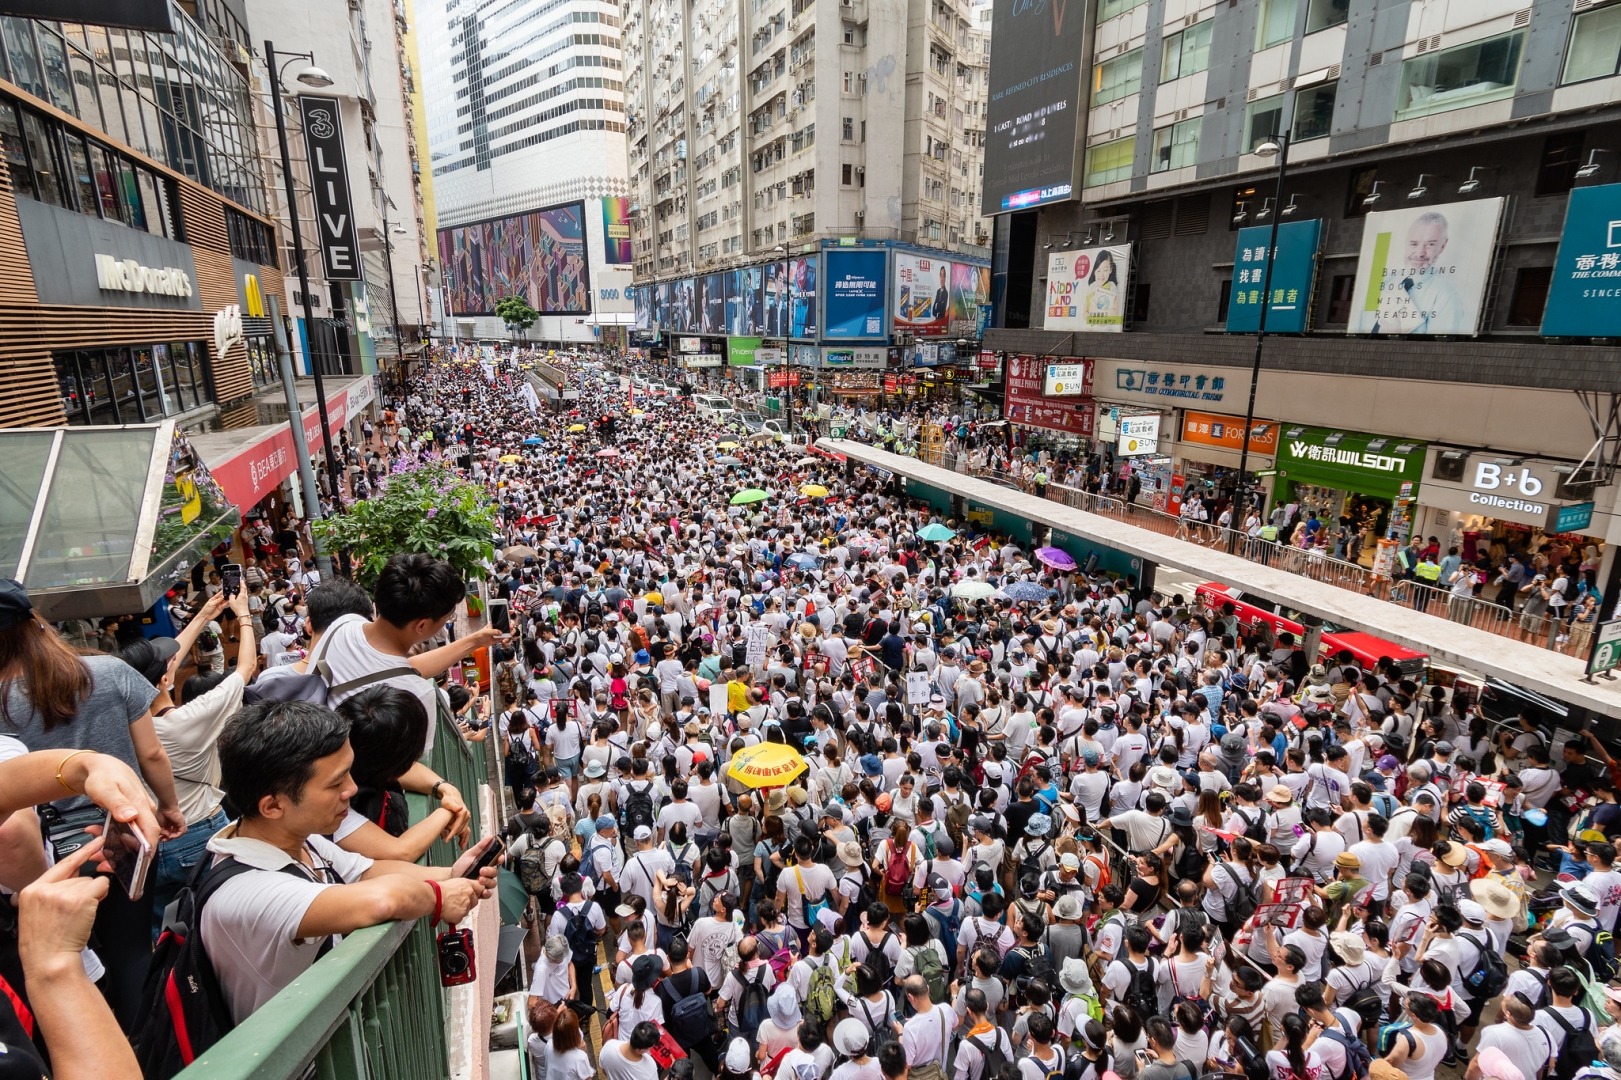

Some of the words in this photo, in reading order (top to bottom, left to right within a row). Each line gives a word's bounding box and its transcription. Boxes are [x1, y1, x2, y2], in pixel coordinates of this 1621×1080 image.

[1040, 62, 1074, 82] RESIDENCES
[316, 147, 354, 270] LIVE
[94, 253, 193, 298] McDonald's
[1239, 268, 1262, 283] 找書
[1382, 266, 1456, 277] BRIDGING
[1571, 271, 1591, 279] THE
[600, 289, 619, 300] SOGO
[1583, 288, 1621, 298] SINCE
[1049, 295, 1071, 306] LAND
[1377, 297, 1411, 305] WITH
[1375, 310, 1437, 319] READERS
[828, 353, 852, 361] Cetaphil
[1009, 378, 1024, 387] MOBILE
[257, 457, 271, 480] BEA
[1470, 492, 1543, 515] Collection
